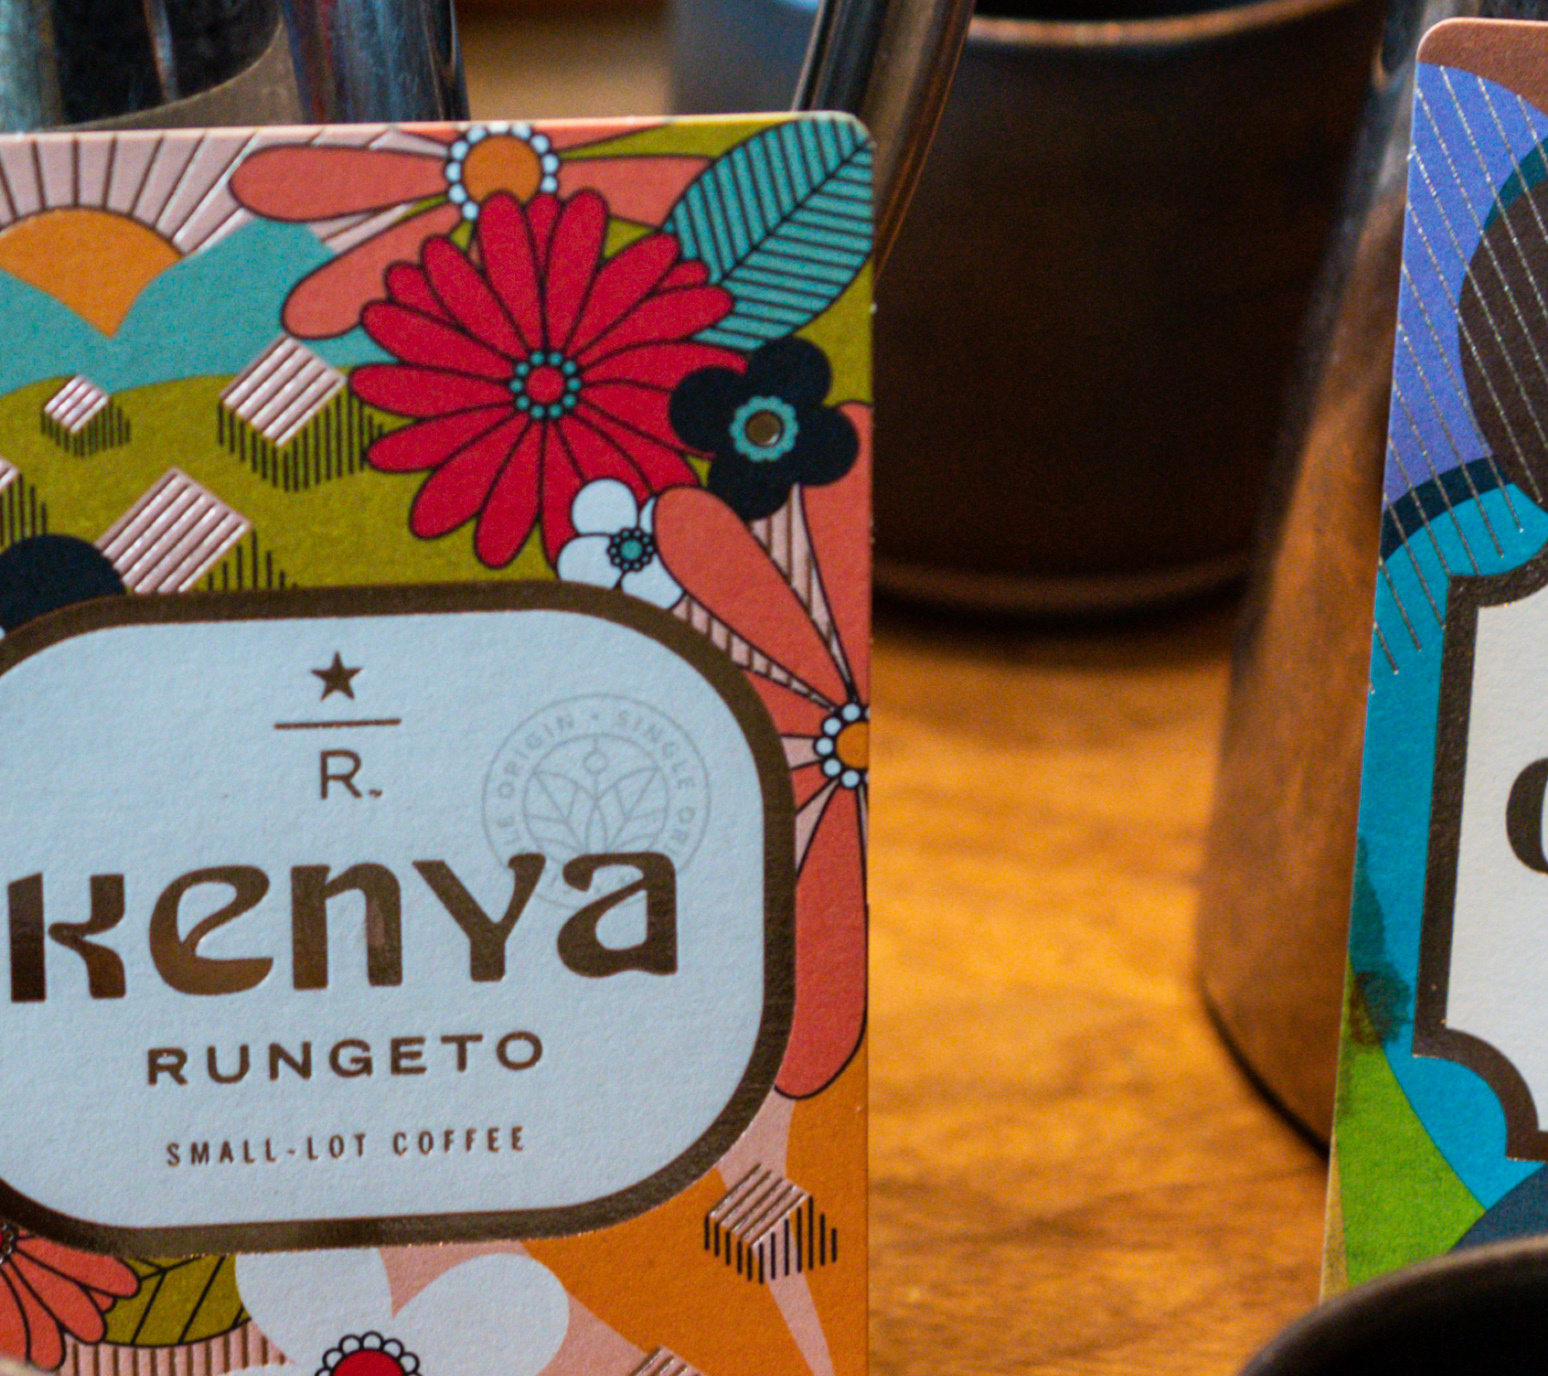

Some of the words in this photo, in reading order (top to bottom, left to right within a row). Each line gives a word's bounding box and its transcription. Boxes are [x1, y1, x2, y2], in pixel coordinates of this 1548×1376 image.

[498, 714, 574, 799] ORIGIN
[618, 711, 695, 789] SINGLE
[147, 1030, 543, 1086] RUNGETO
[166, 1133, 365, 1167] SMALL-LOT
[392, 1126, 523, 1156] COFFEE
